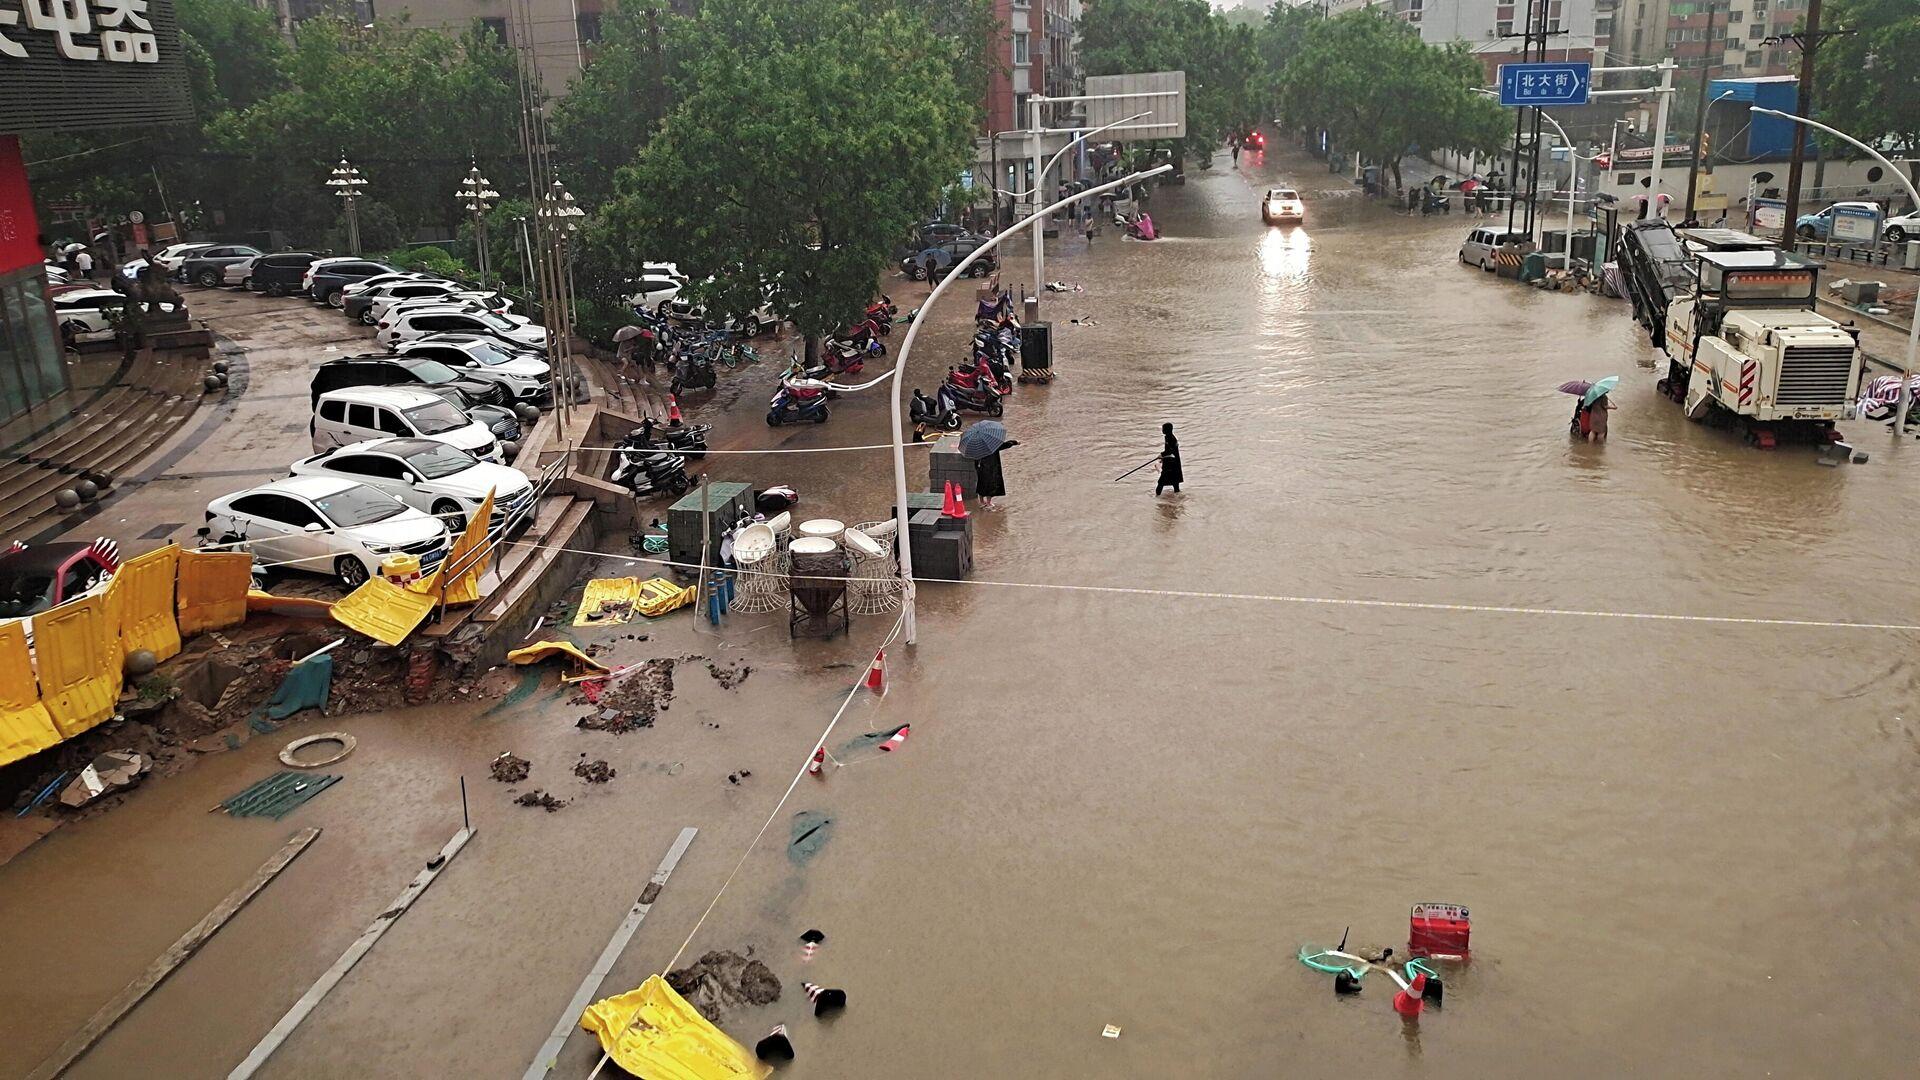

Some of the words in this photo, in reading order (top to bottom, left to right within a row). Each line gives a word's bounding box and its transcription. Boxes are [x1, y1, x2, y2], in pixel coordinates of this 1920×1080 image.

[0, 0, 159, 62] 电器
[1522, 73, 1569, 87] 北大街
